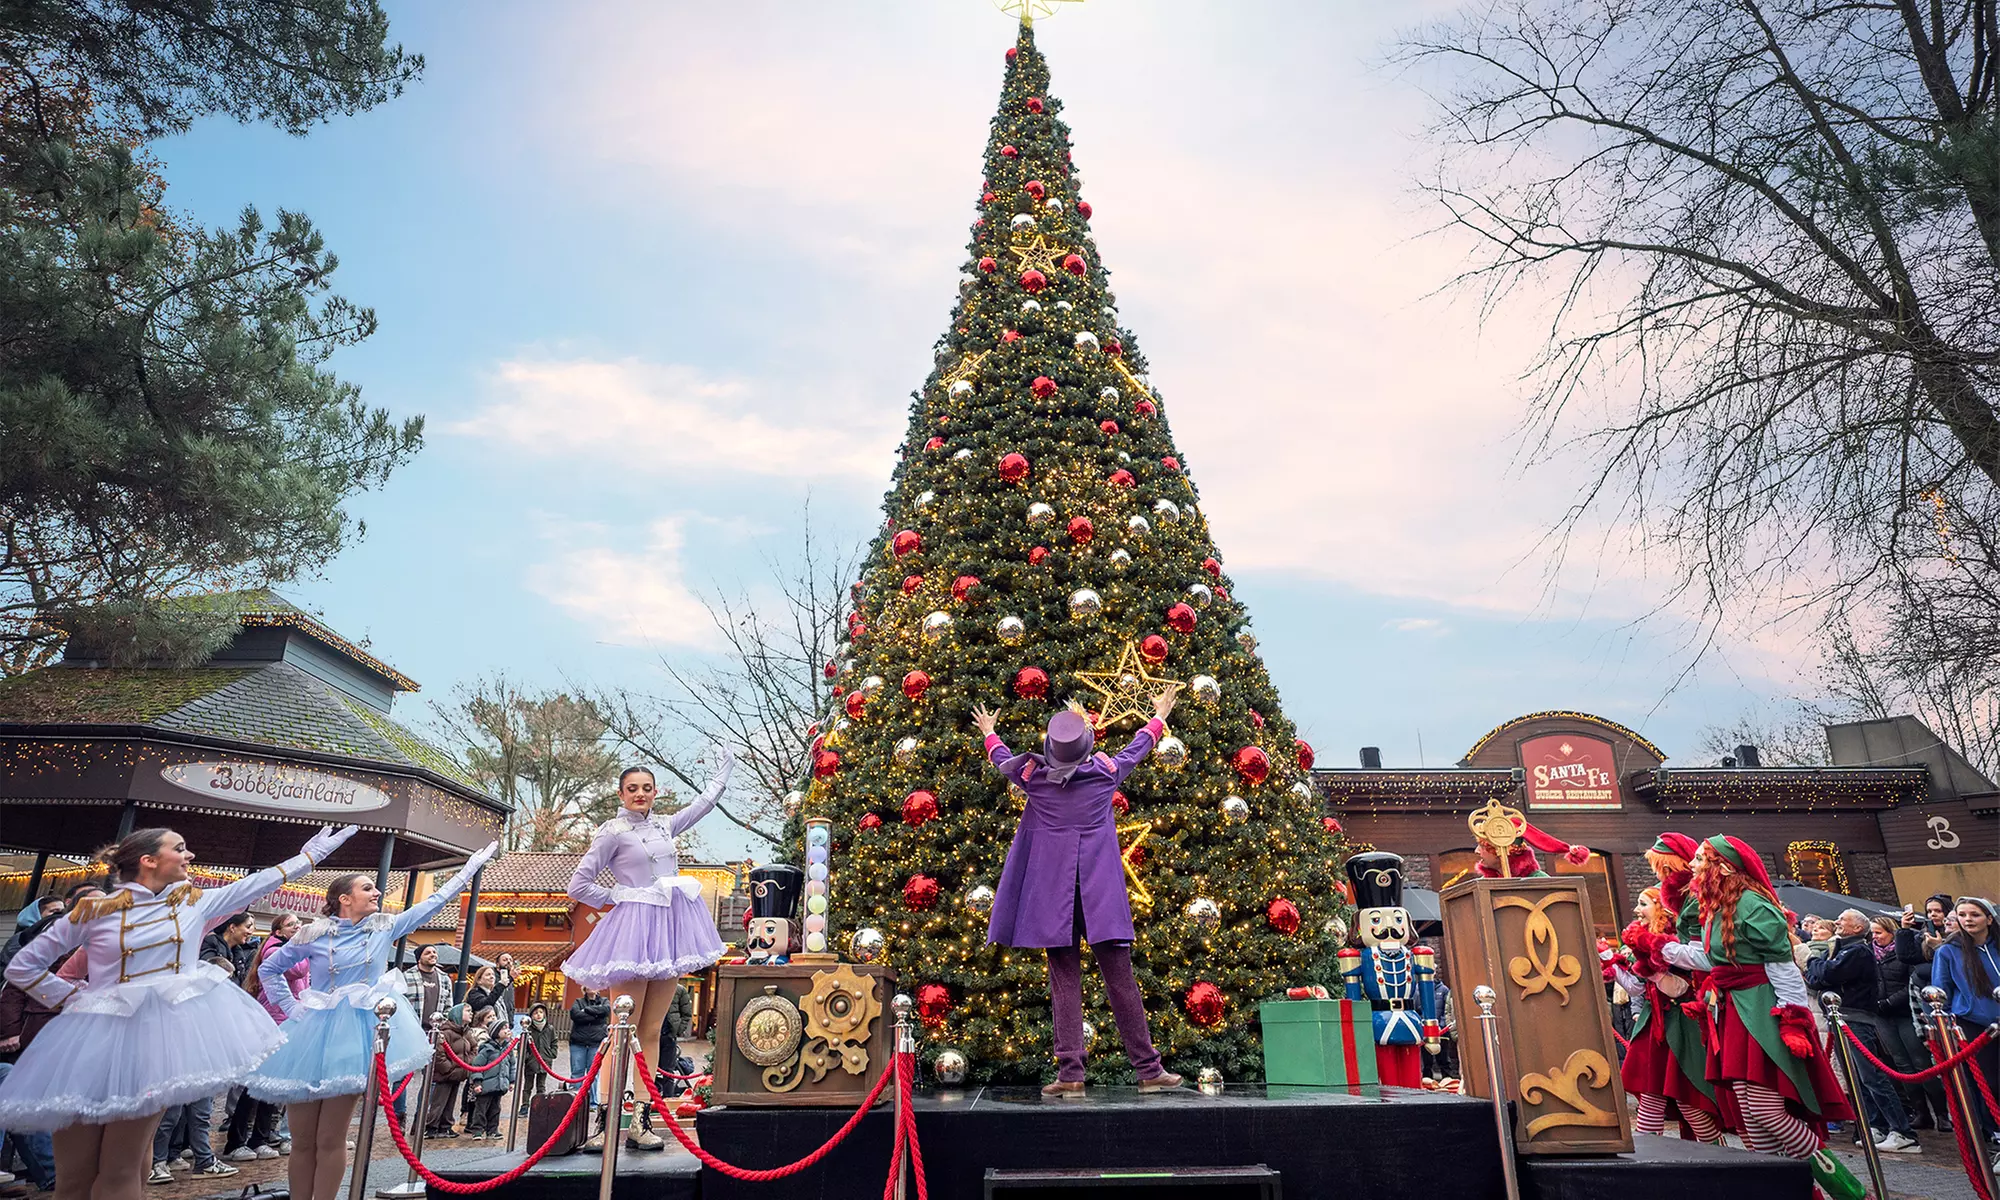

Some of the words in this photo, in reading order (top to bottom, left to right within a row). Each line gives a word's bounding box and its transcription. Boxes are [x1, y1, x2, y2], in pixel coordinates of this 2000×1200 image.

[210, 766, 356, 805] Bobbejaanland
[1535, 789, 1564, 800] BURGER
[1565, 789, 1613, 800] RESTAURANT
[1926, 816, 1961, 850] B
[271, 888, 325, 913] COOKOU
